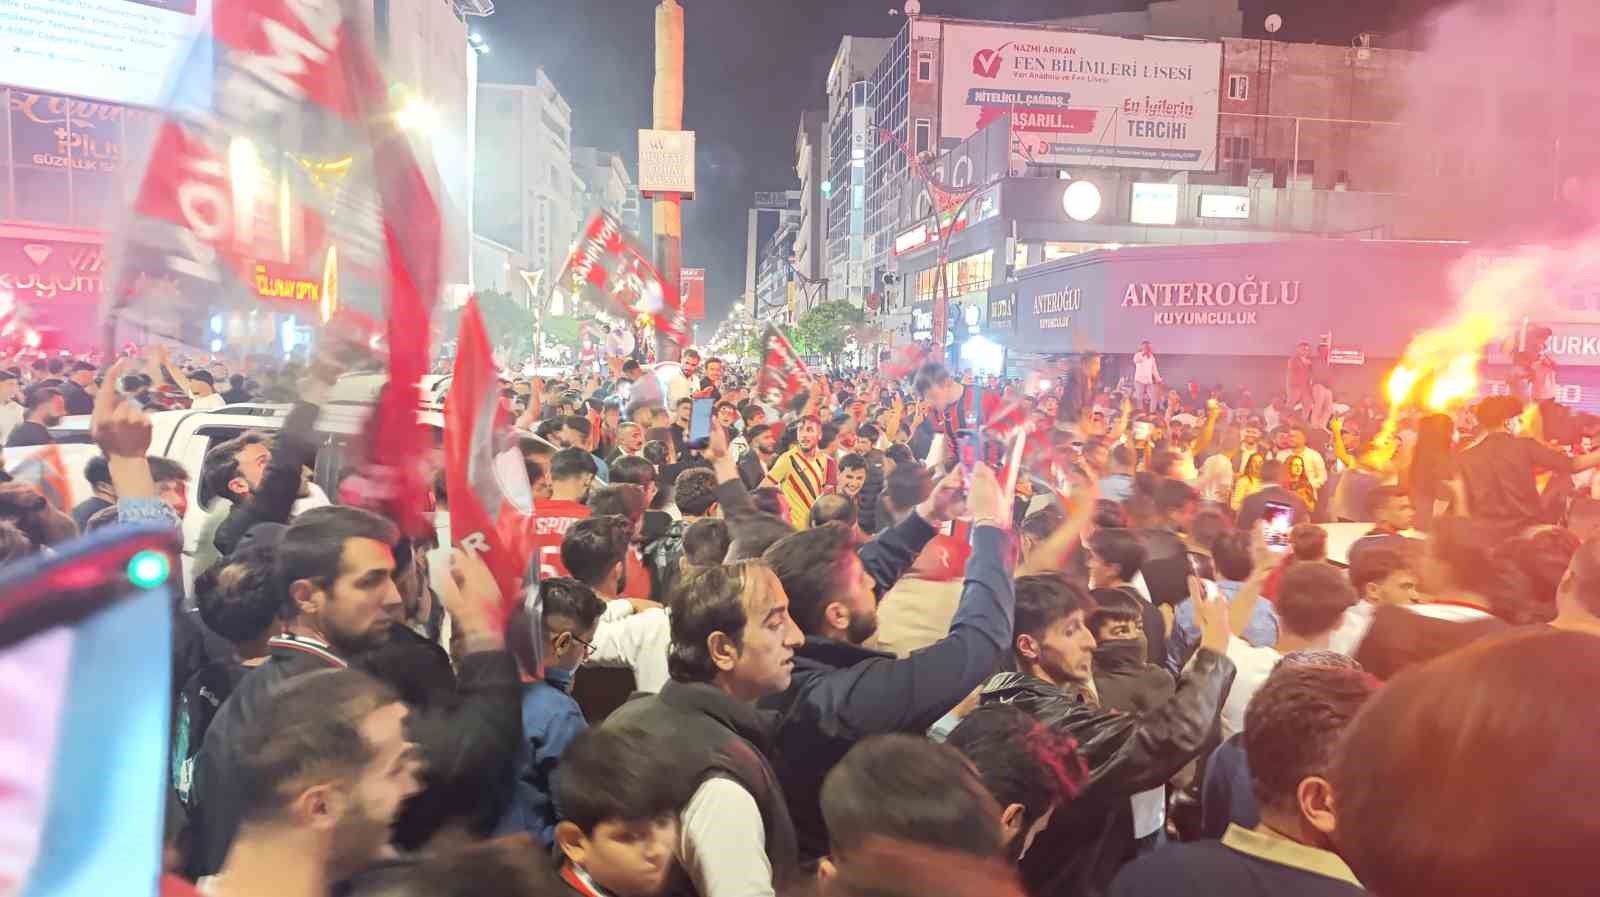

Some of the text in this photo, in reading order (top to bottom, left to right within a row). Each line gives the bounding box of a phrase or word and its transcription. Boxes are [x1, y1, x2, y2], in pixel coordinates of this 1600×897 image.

[1014, 56, 1046, 70] FEN
[1051, 56, 1137, 77] BİLİMLERİ
[1011, 111, 1074, 130] AŞARILI...
[1128, 119, 1187, 140] TERCİHİ
[1033, 288, 1081, 314] ANTEROĞLU
[1121, 273, 1301, 309] ANTEROĞLU
[1154, 311, 1257, 326] KUYUMCULUK
